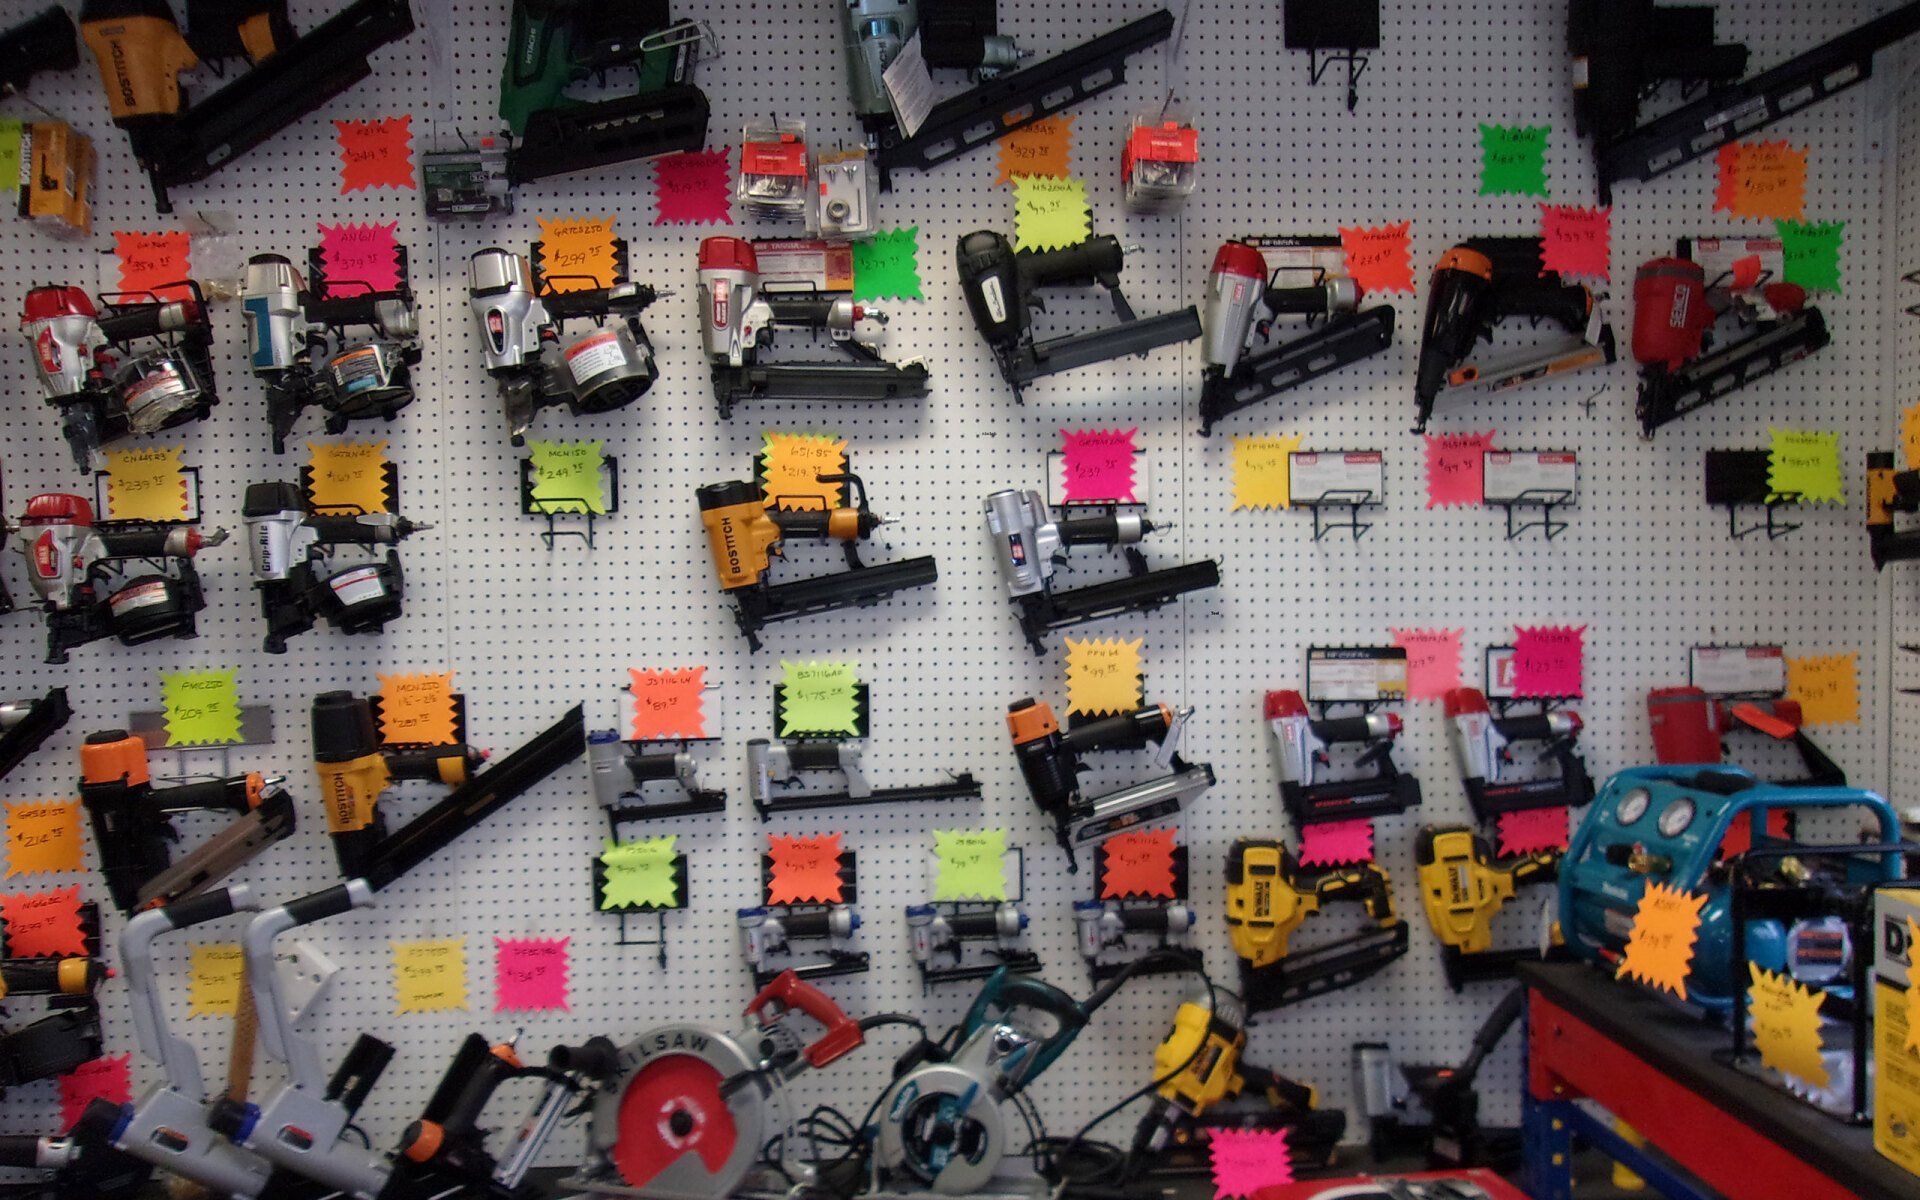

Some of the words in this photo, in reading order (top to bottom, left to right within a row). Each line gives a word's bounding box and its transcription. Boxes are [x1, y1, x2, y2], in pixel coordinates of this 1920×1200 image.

[526, 27, 537, 64] HITACHI
[111, 40, 137, 107] BOSTITCH
[1670, 284, 1690, 329] SENCO
[259, 524, 271, 573] Grip-Rite
[722, 516, 742, 575] BOSTITCH
[333, 771, 351, 825] BOSTITCH
[610, 1029, 709, 1094] SKILSAW
